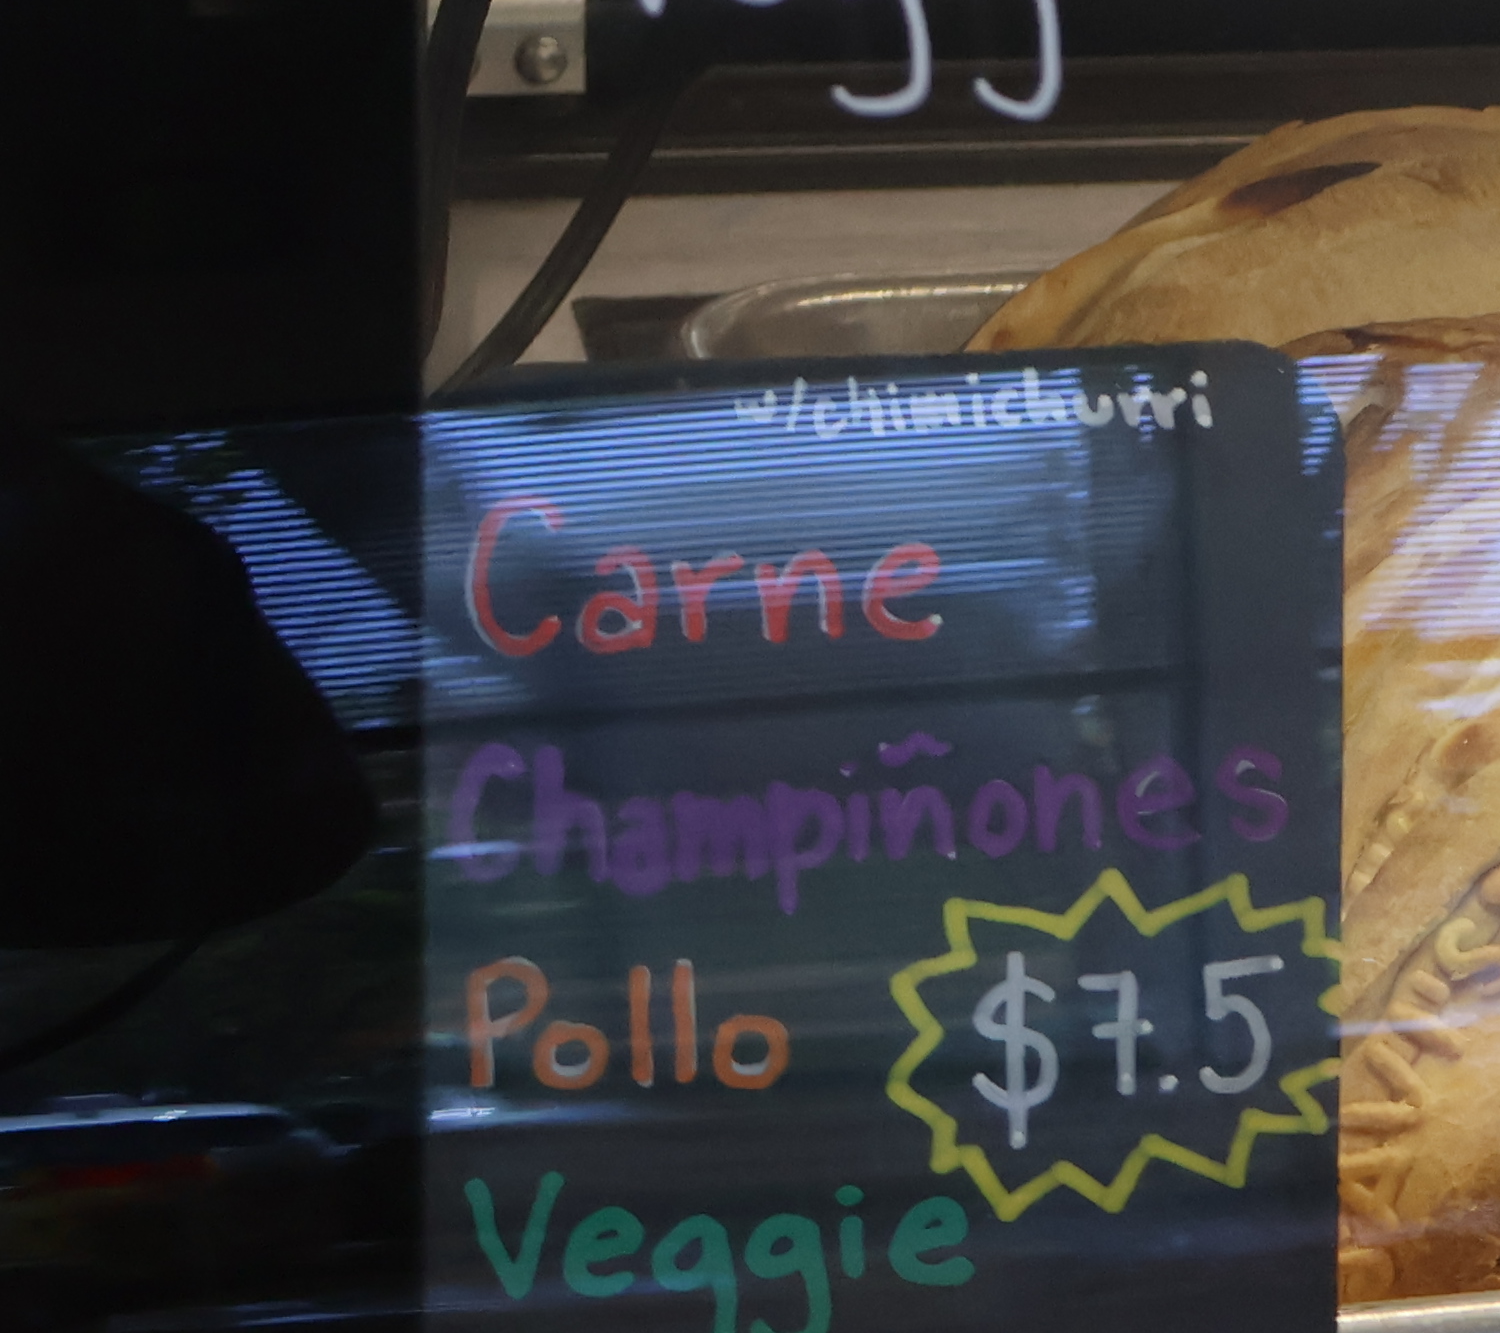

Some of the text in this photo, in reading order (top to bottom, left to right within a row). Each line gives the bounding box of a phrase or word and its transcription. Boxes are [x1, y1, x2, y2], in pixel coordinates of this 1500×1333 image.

[733, 365, 1214, 439] w/chimichurri
[465, 495, 943, 656] Carne
[449, 733, 1291, 916] Champiñones
[466, 956, 792, 1091] Pollo
[971, 950, 1286, 1149] $7.5
[465, 1170, 977, 1333] Veggie
